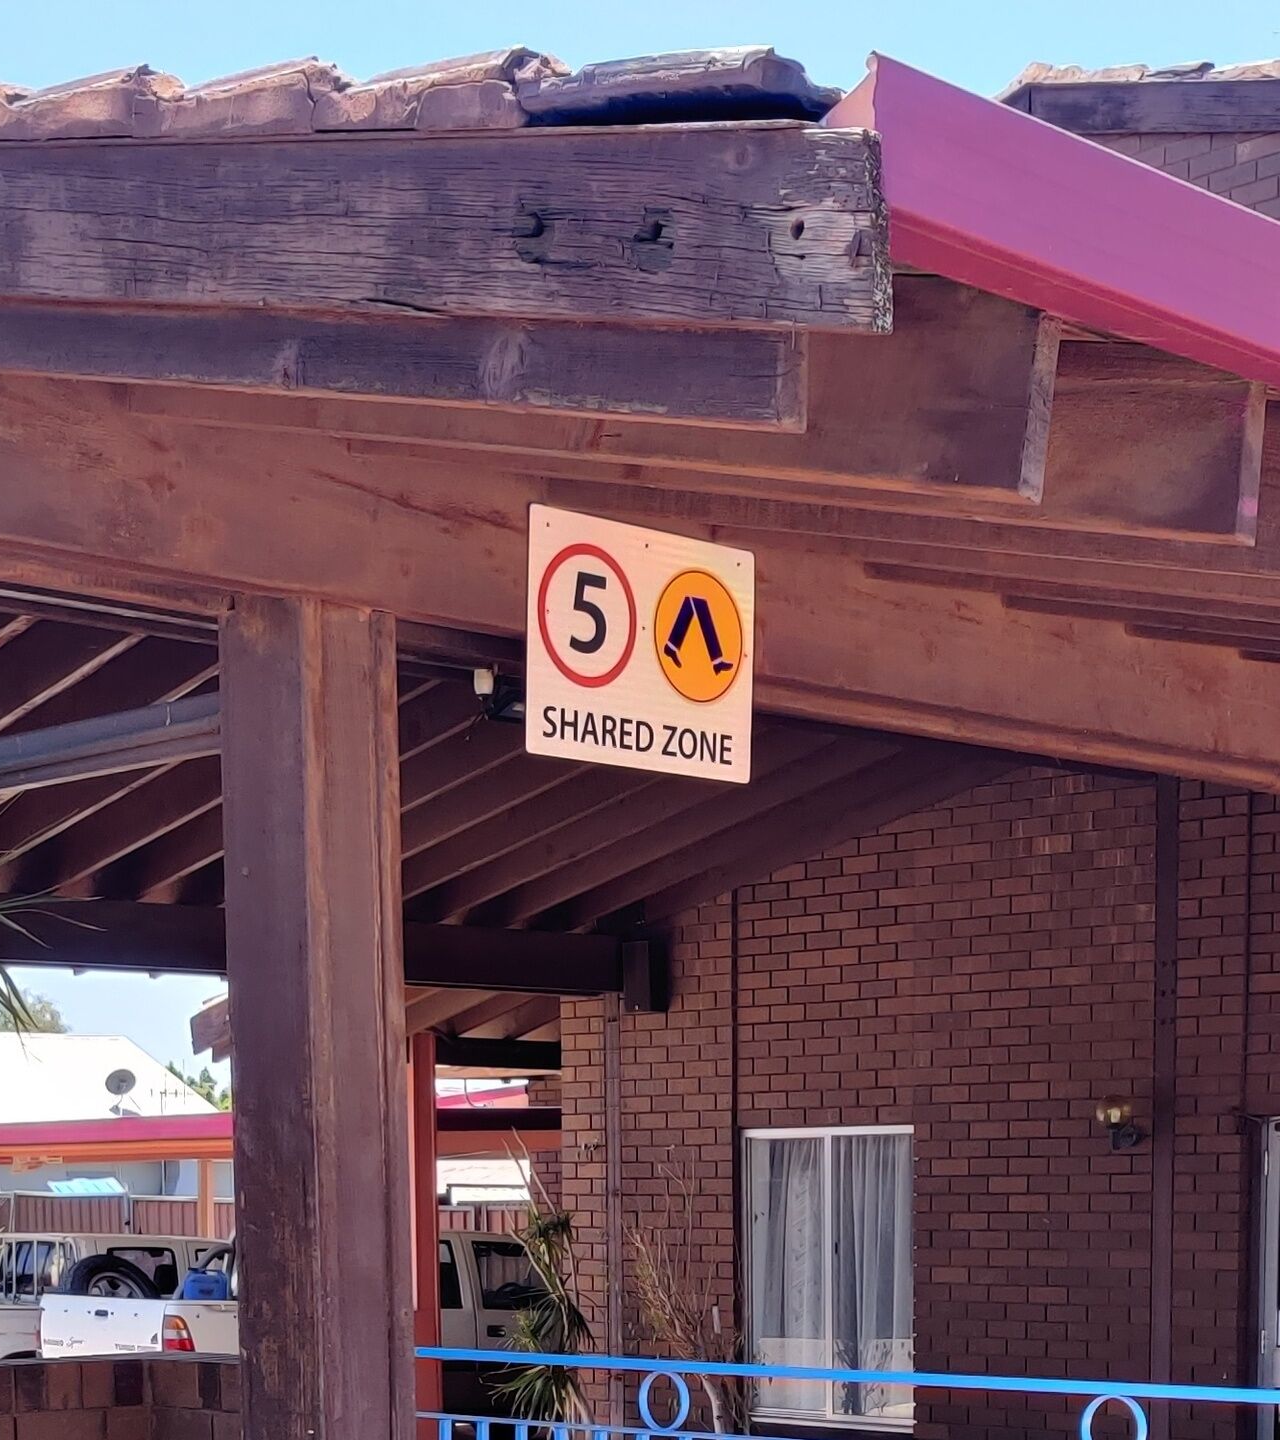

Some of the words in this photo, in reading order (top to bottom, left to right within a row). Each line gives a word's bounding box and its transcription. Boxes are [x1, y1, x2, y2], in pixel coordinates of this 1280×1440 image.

[569, 571, 607, 654] 5
[542, 705, 654, 752] SHARED
[661, 725, 733, 766] ZONE
